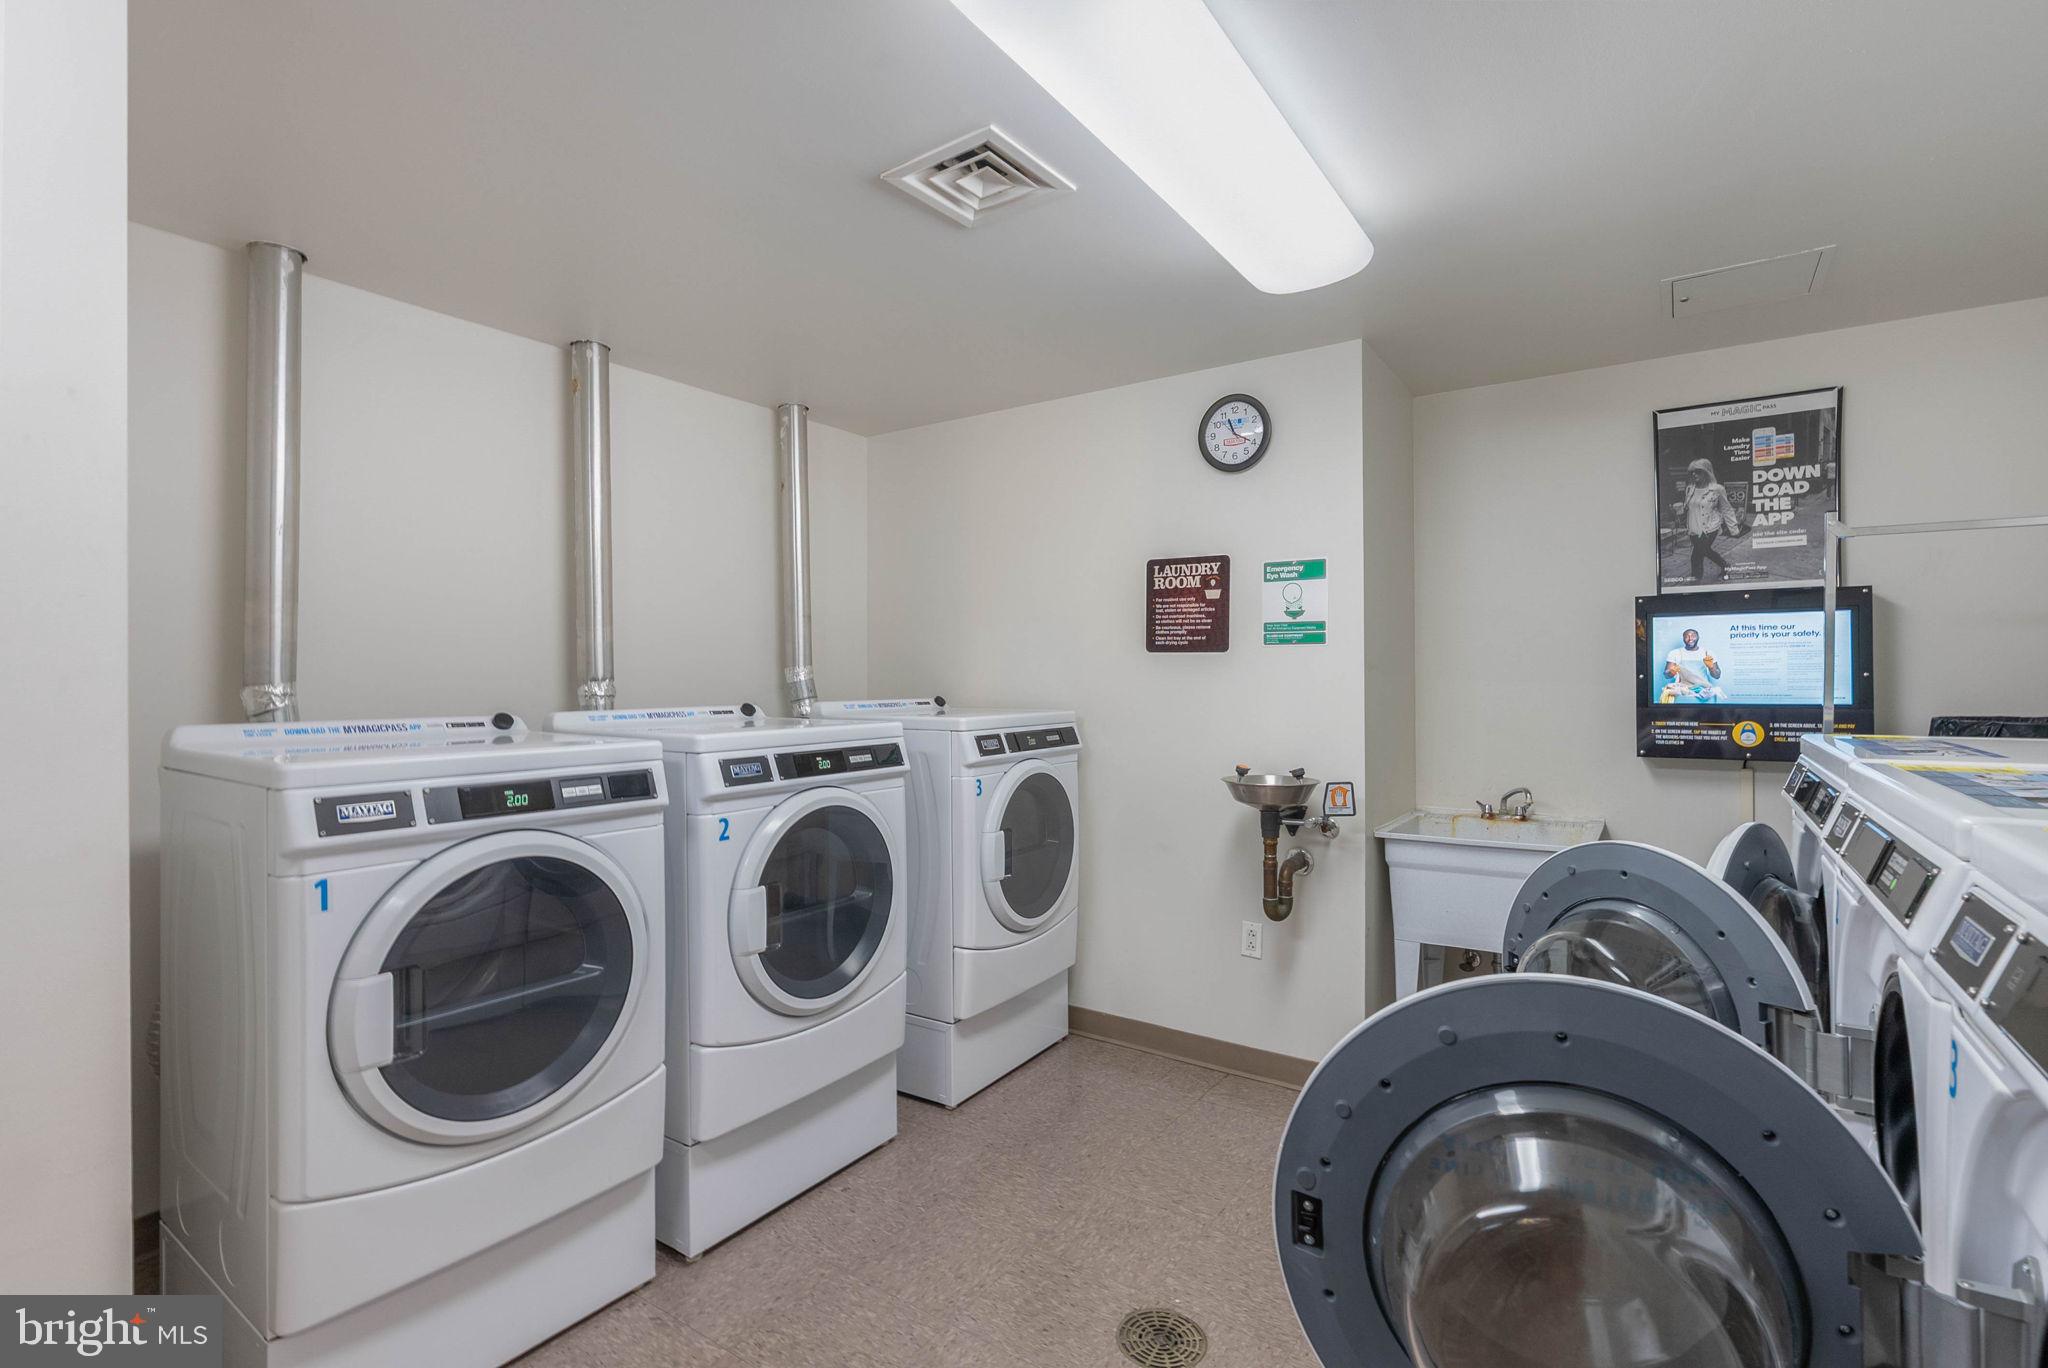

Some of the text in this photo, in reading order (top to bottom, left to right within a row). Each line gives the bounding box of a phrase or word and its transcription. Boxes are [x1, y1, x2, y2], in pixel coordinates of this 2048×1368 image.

[1231, 406, 1239, 414] 12
[1722, 403, 1762, 416] MAGIC
[1213, 421, 1221, 429] 10
[1252, 415, 1257, 423] 2
[1210, 432, 1216, 440] 9
[1222, 450, 1228, 458] 7
[1243, 447, 1250, 455] 5
[1723, 443, 1751, 451] Laundry
[1232, 452, 1239, 460] 6
[1752, 464, 1820, 484] DOWN
[1752, 480, 1810, 498] LOAD
[1752, 497, 1792, 513] THE
[1751, 511, 1795, 527] APP
[1153, 562, 1221, 577] LAUNDRY
[1153, 575, 1202, 590] ROOM
[1730, 631, 1760, 640] priority
[647, 711, 687, 719] MYMAGICPASS
[284, 727, 326, 735] DOWNLOAD
[342, 723, 408, 734] MYMAGICPASS
[976, 779, 982, 797] 3
[506, 793, 529, 808] 2.00
[340, 802, 393, 818] MAYTAG
[718, 817, 730, 841] 2
[313, 878, 328, 912] 1
[1949, 1039, 1959, 1098] 3
